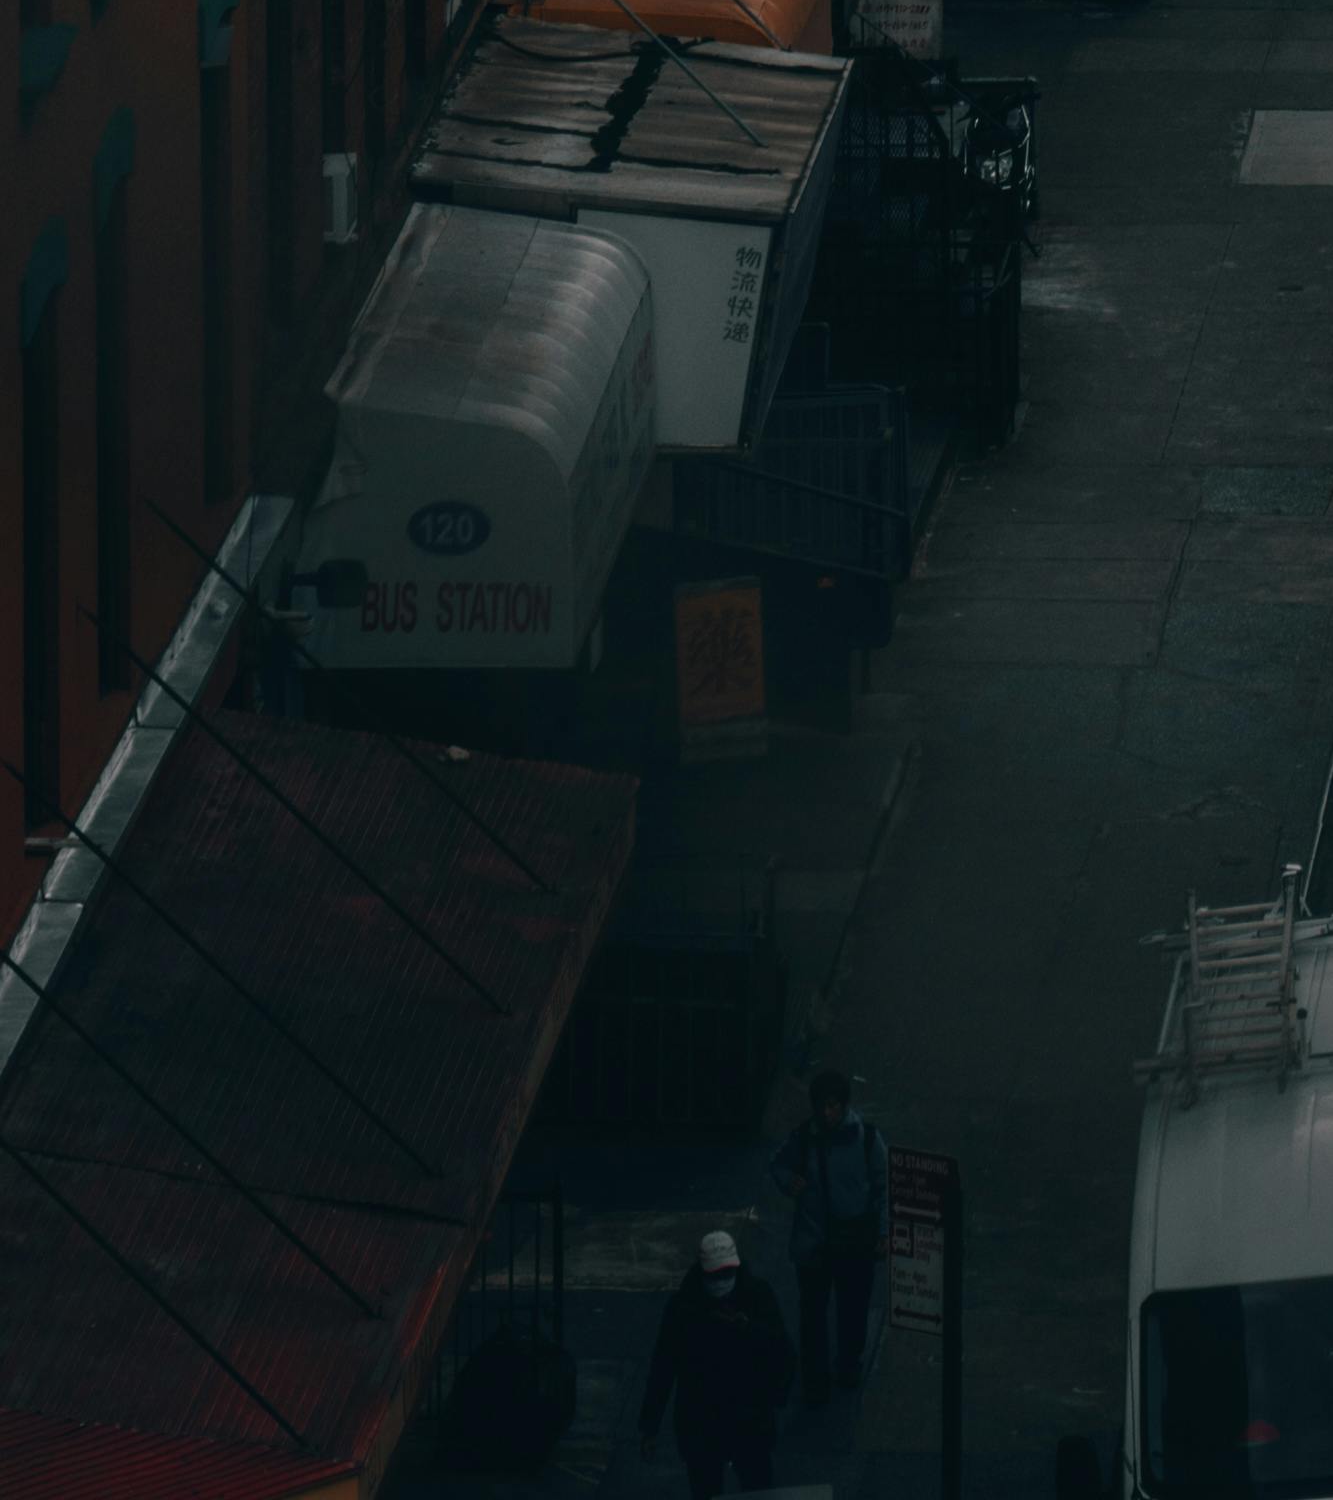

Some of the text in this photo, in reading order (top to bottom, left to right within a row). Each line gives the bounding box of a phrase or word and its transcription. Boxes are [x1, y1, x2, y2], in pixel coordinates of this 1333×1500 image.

[419, 511, 477, 546] 120
[360, 580, 552, 633] BUS STATION
